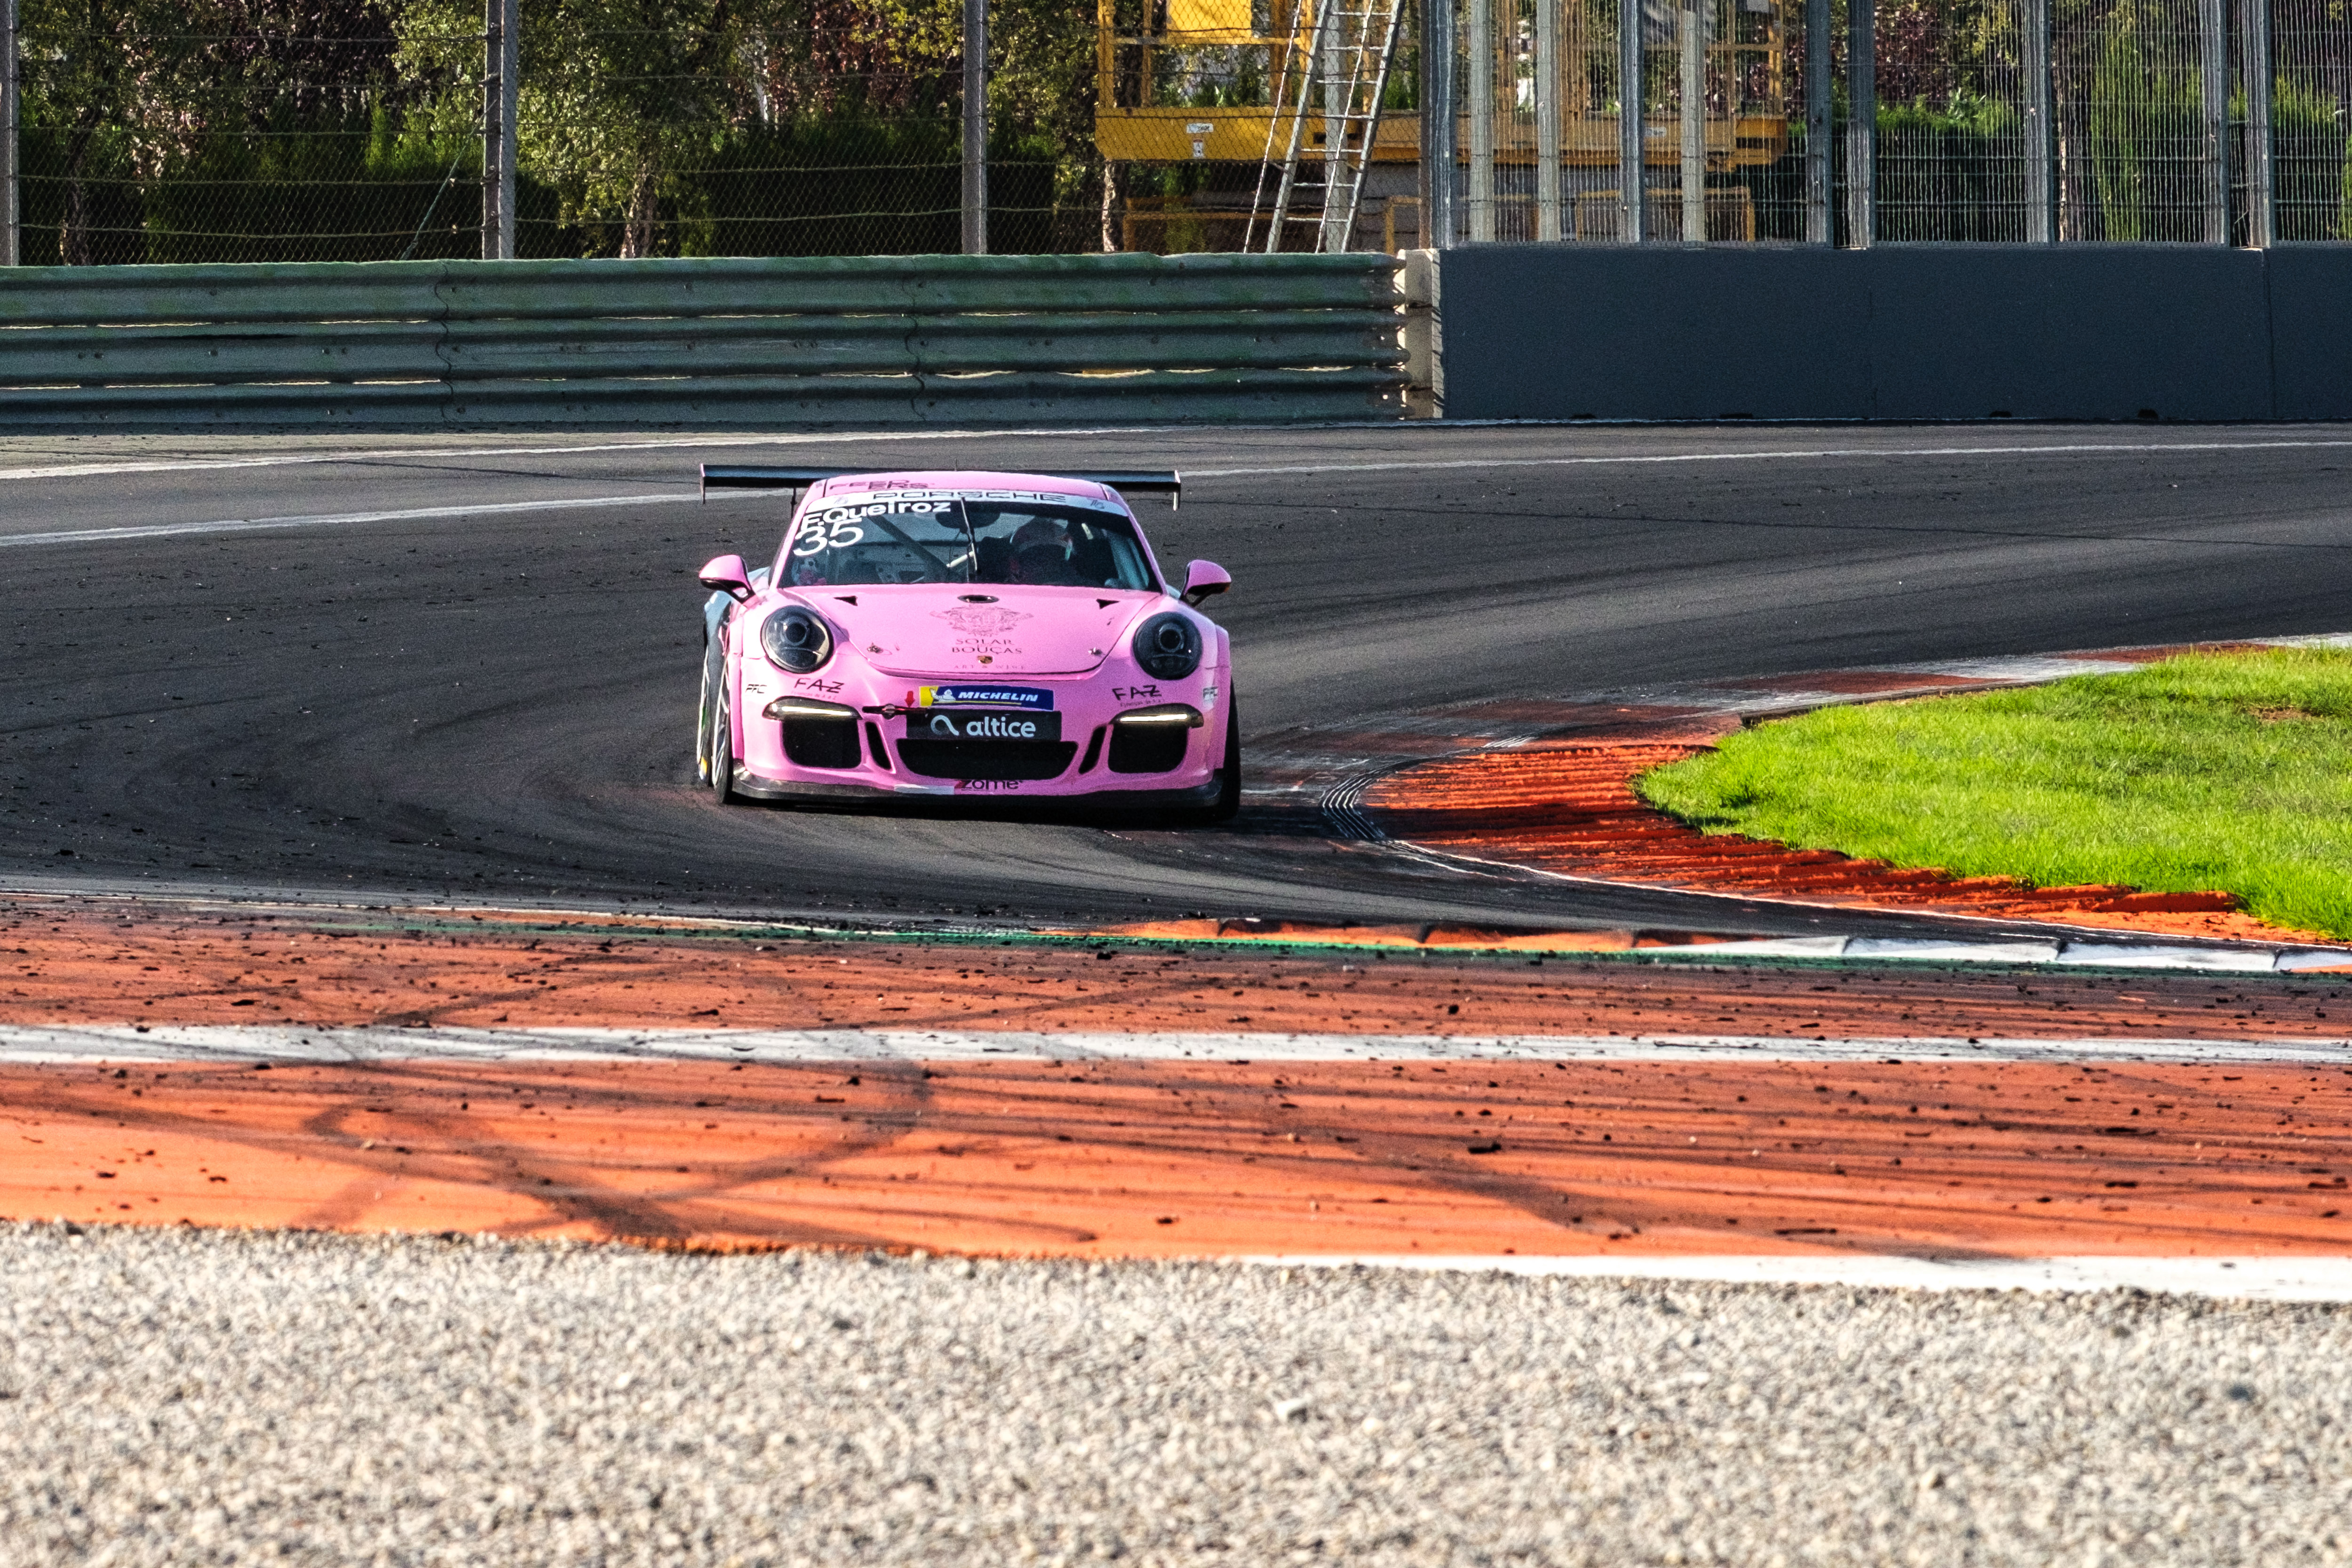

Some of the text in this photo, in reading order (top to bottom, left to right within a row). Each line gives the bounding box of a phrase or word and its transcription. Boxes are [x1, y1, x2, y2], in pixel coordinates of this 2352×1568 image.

[874, 491, 1066, 502] PORSCHE
[794, 518, 864, 556] 35
[952, 645, 1022, 654] BOUÇAS
[794, 678, 844, 693] FAZ
[1112, 685, 1162, 700] FAZ
[958, 692, 1038, 702] MICHELIN
[966, 716, 1036, 738] altice
